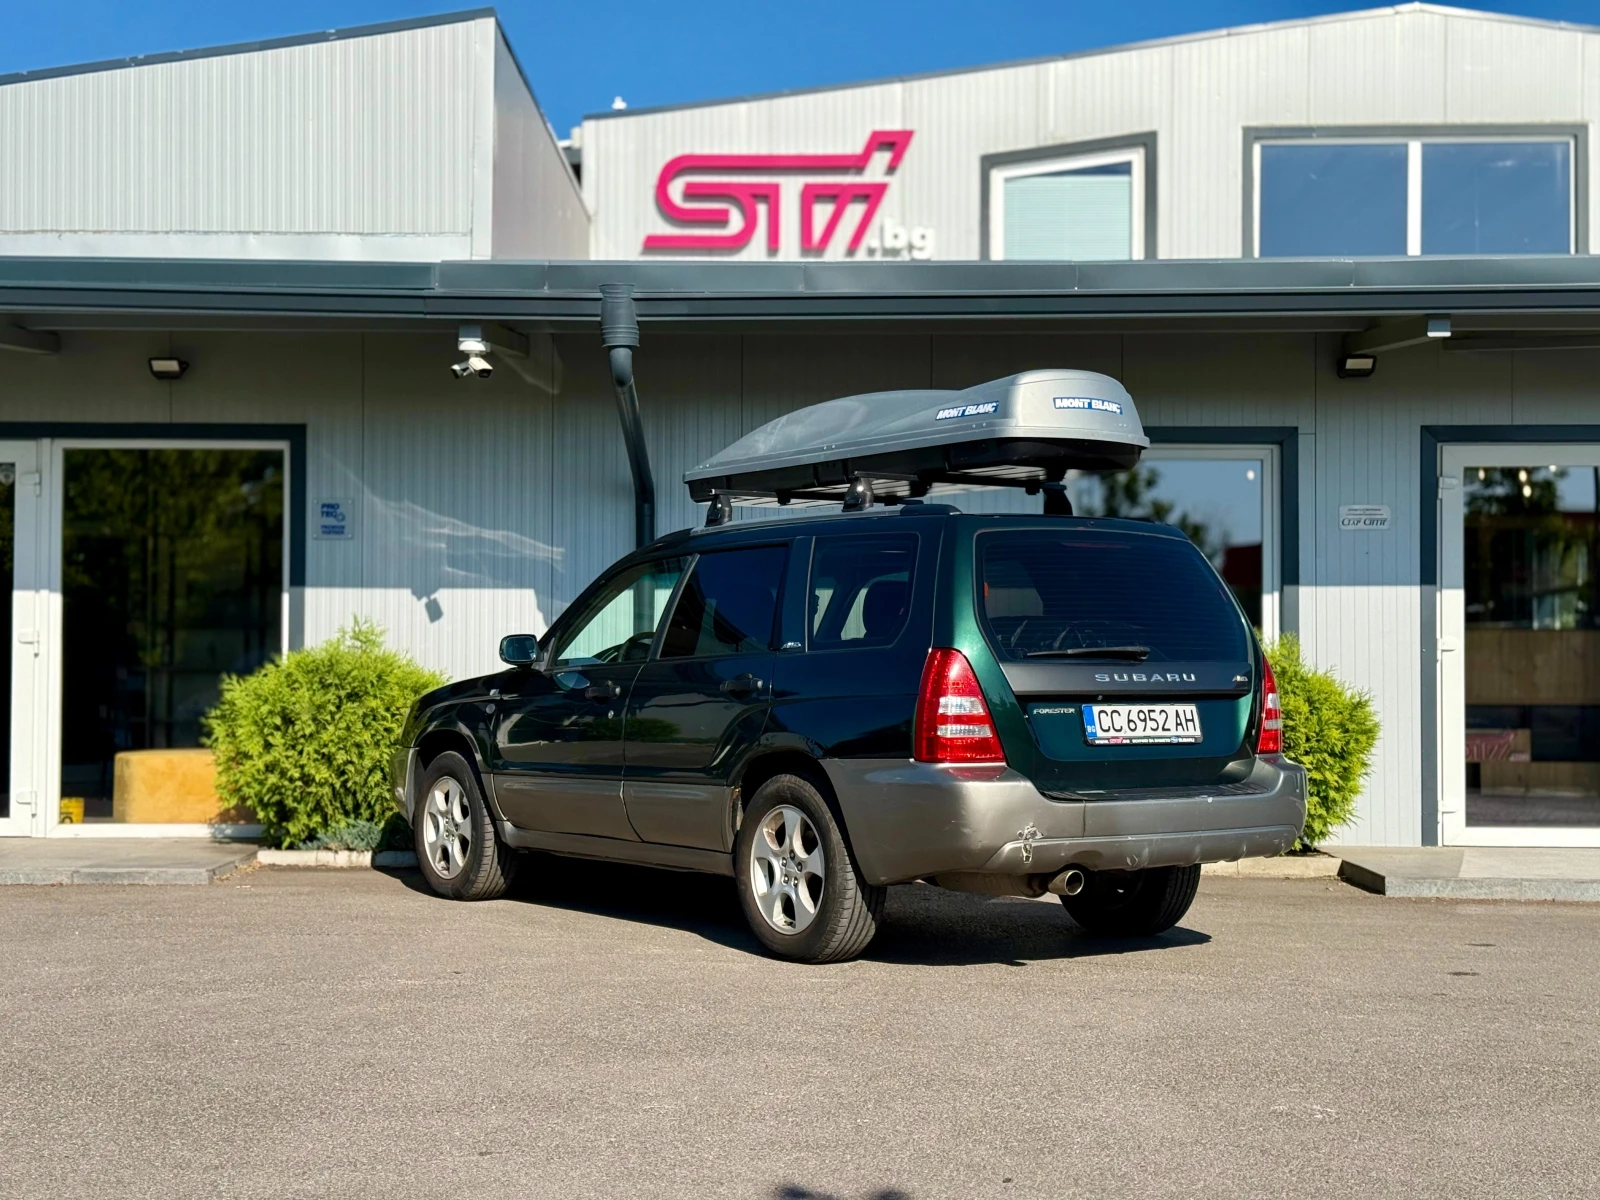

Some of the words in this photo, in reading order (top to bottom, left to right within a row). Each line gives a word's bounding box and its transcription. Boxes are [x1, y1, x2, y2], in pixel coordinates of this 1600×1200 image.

[936, 405, 965, 420] MONT
[964, 402, 998, 417] BLANC
[1054, 397, 1090, 409] MONT
[1091, 399, 1122, 413] BLANC
[1094, 673, 1197, 682] SUBARU
